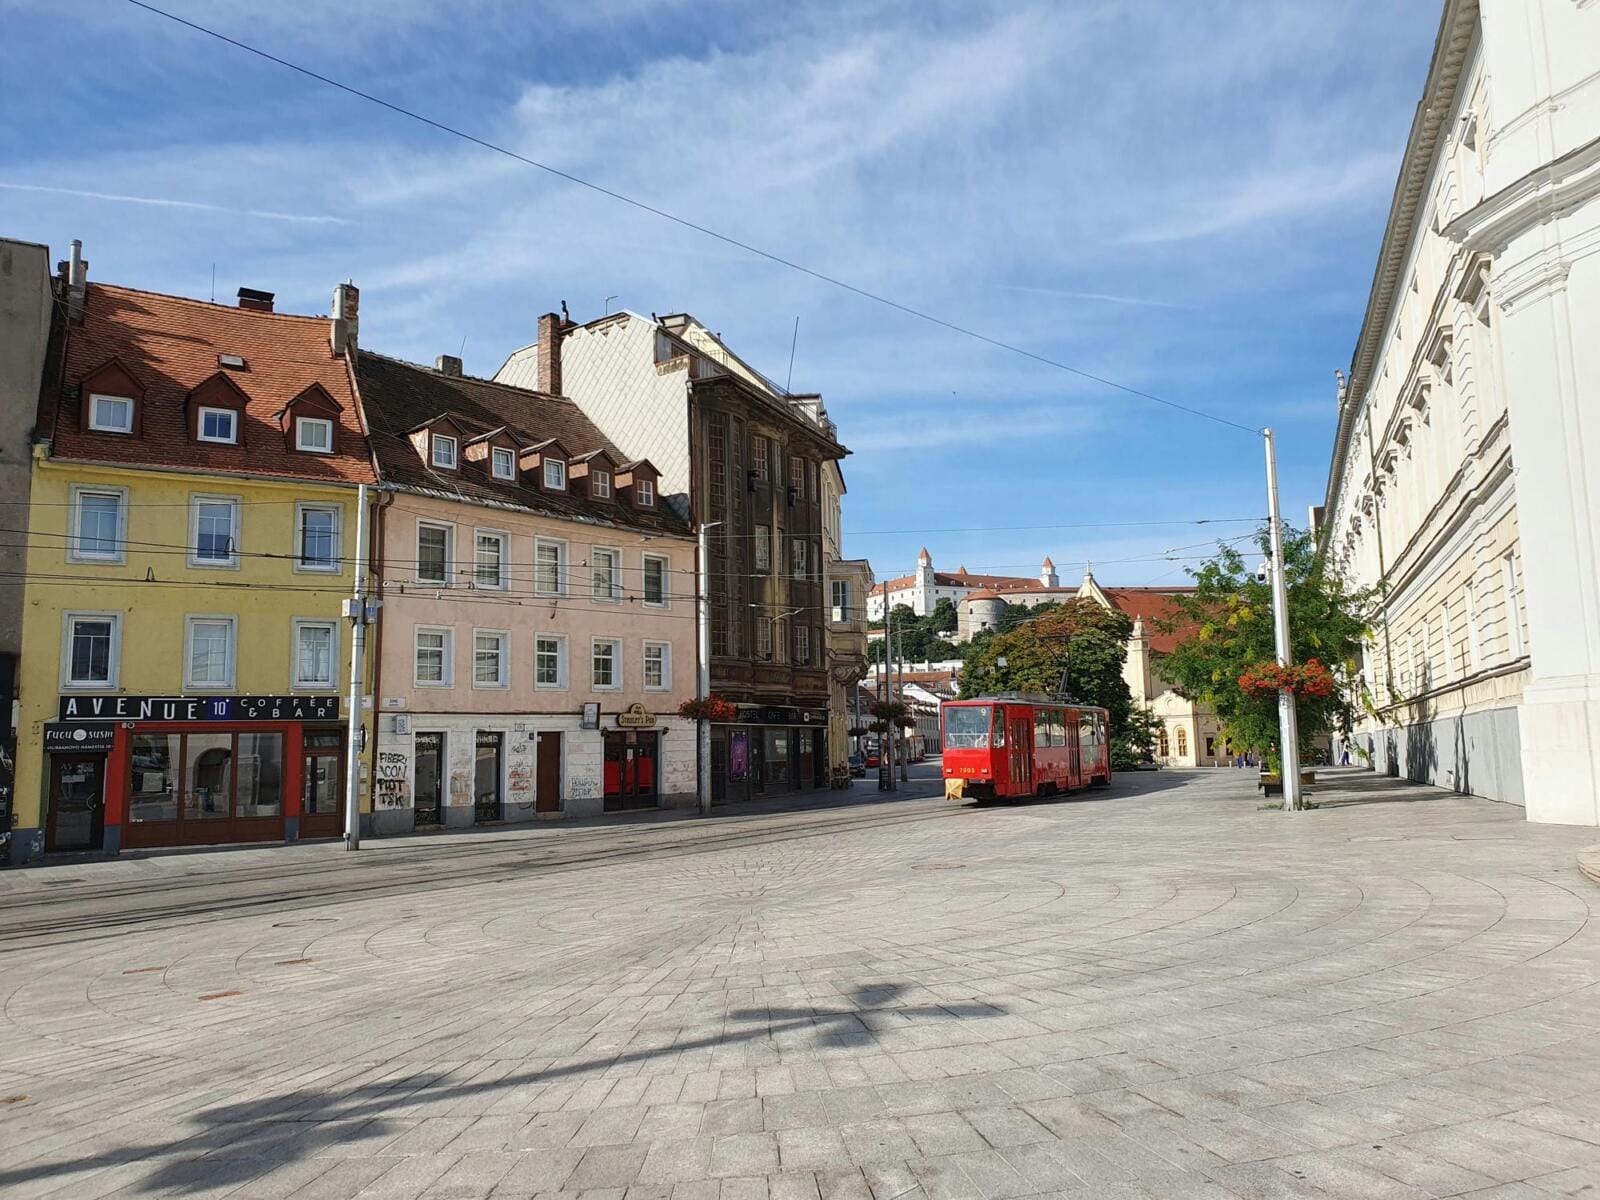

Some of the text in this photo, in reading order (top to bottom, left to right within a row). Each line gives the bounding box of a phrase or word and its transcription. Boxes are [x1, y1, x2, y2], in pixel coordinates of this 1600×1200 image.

[240, 698, 333, 708] COFFEE
[66, 698, 226, 720] AVENUE 10
[248, 707, 326, 718] & BAR
[980, 708, 987, 717] 9
[46, 730, 113, 740] FUGU SUSHI
